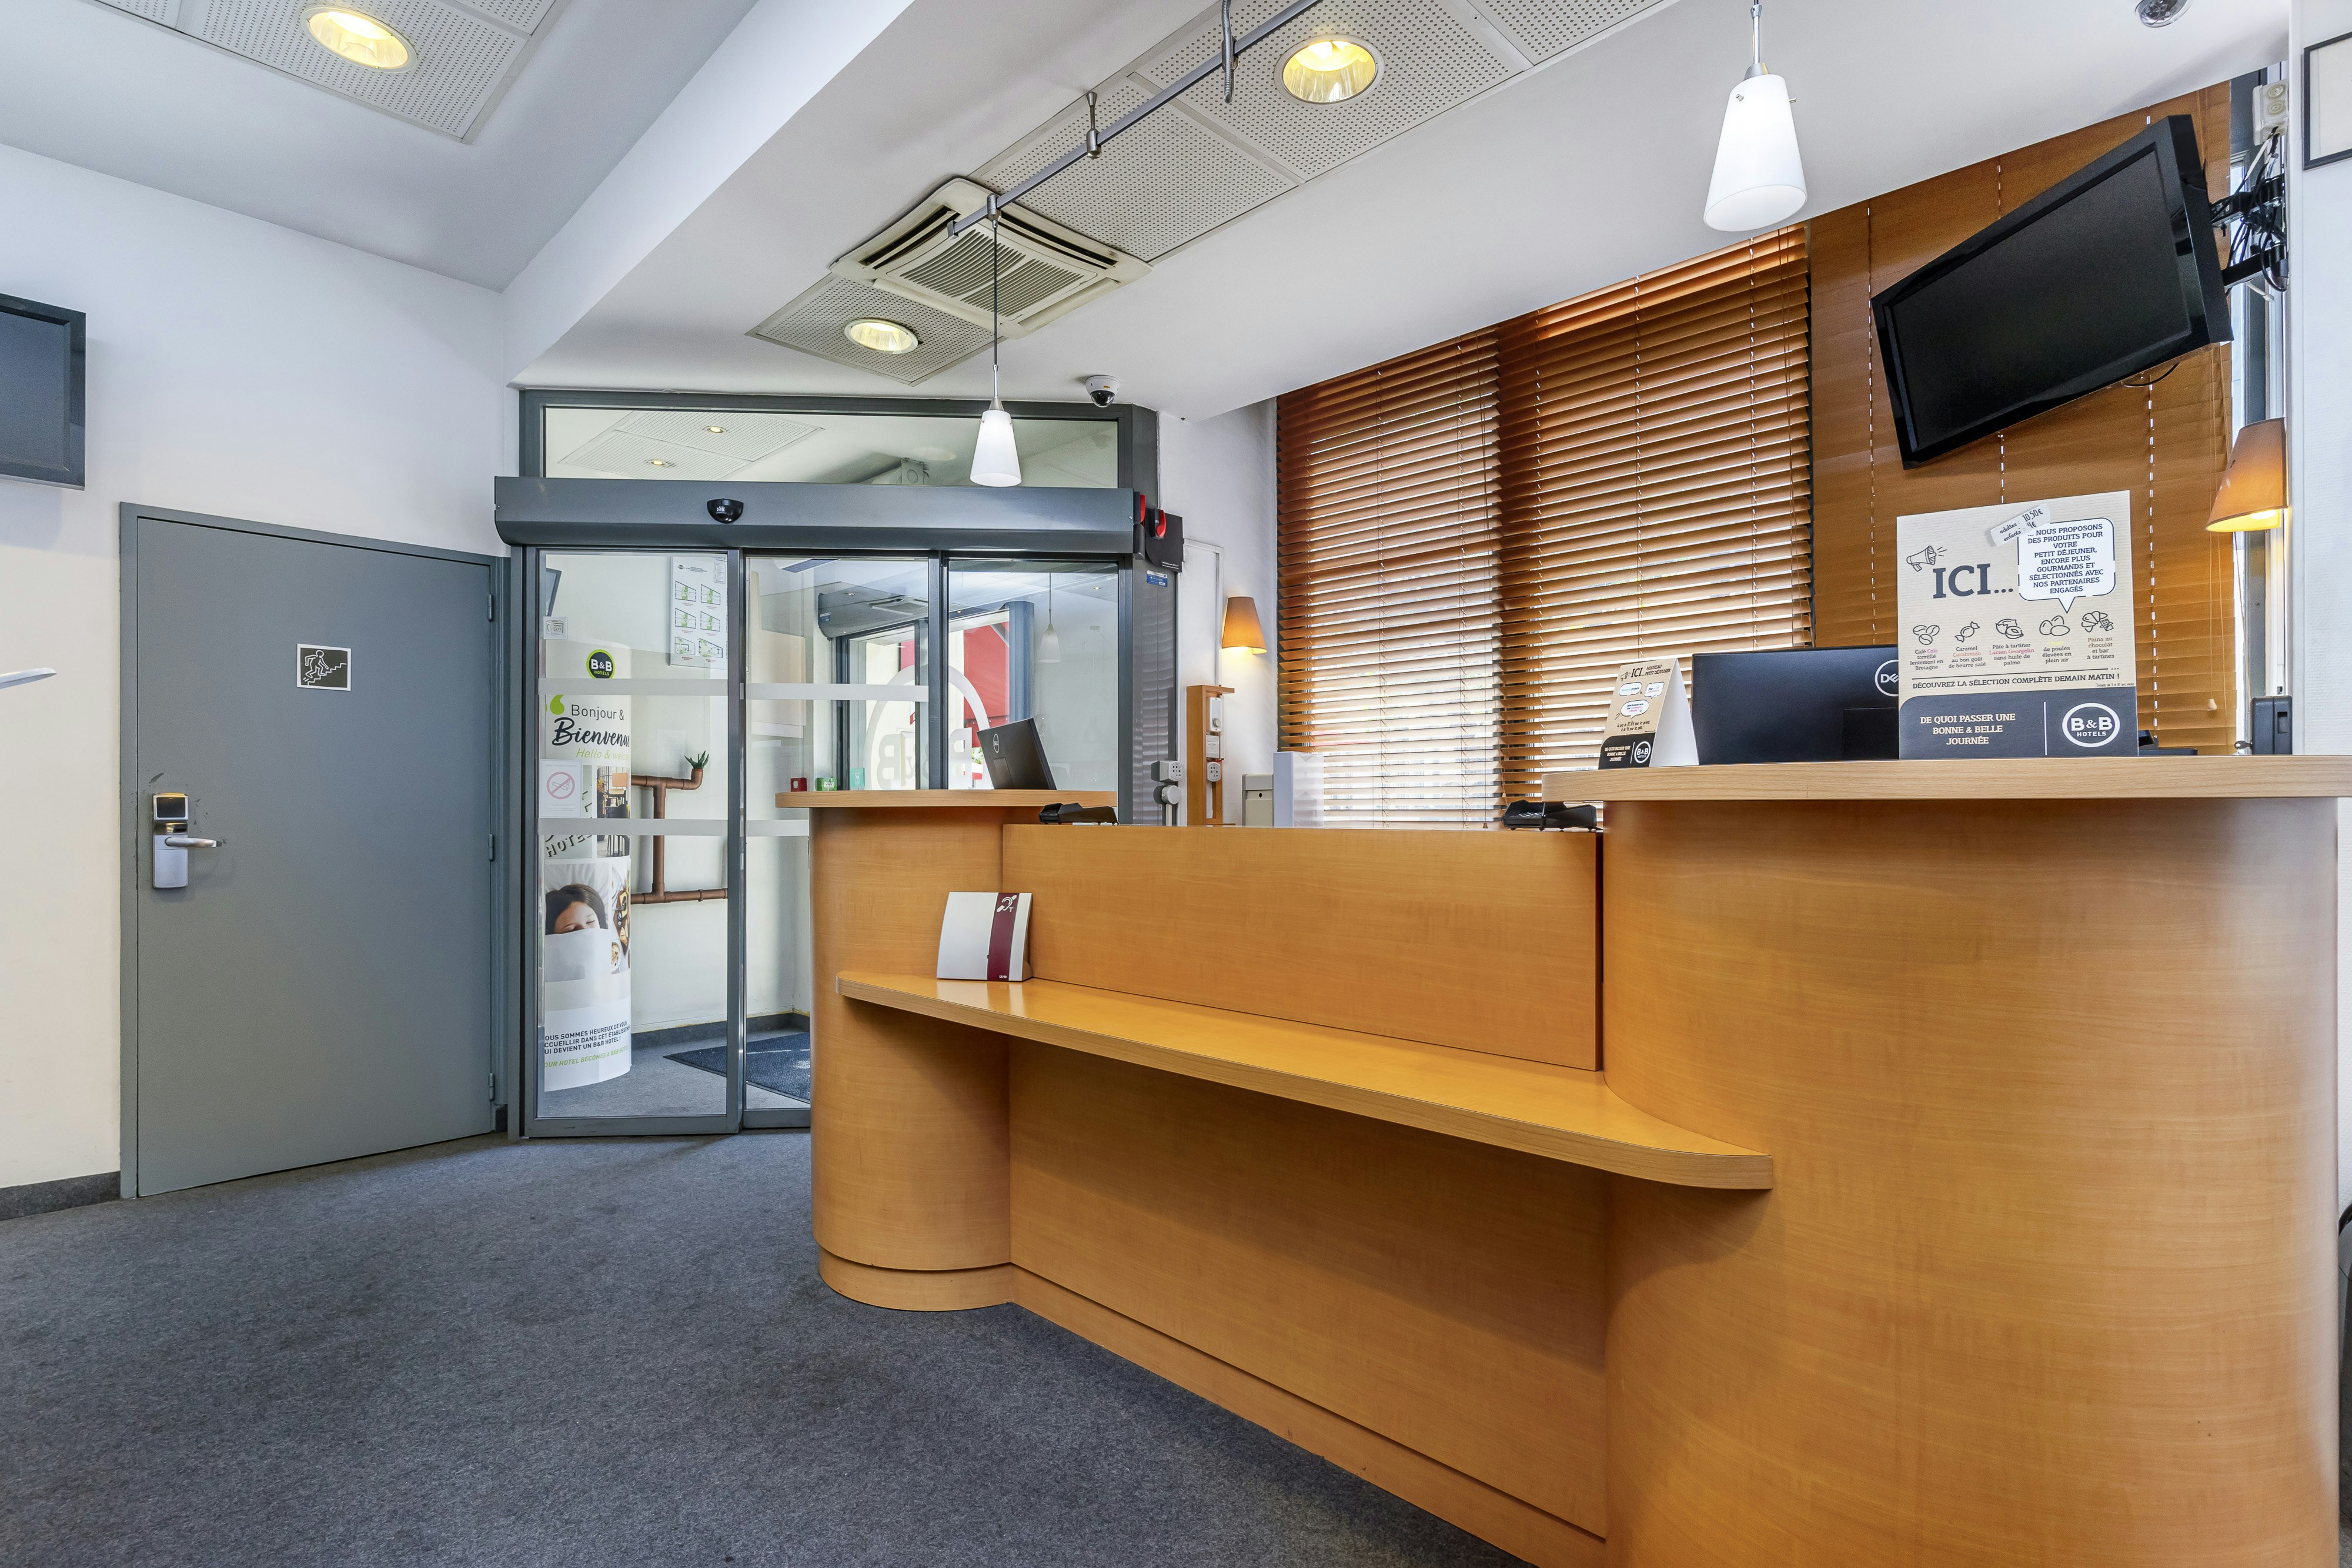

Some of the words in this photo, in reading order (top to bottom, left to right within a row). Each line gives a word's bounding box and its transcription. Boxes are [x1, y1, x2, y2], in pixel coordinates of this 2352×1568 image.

[2000, 522, 2017, 534] adultes
[2022, 509, 2043, 522] 10,50€
[2059, 524, 2103, 533] PROPOSONS
[2043, 534, 2080, 543] PRODUITS
[2057, 547, 2097, 556] DÉJEUNER,
[2037, 563, 2084, 573] GOURMANDS
[2029, 570, 2083, 581] SÉLECTIONNÉS
[1933, 563, 2013, 599] ICI...
[2050, 577, 2100, 587] PARTENAIRES
[591, 658, 612, 672] B&B
[1880, 673, 1899, 683] DE
[2012, 676, 2053, 684] COMPLÈTE
[572, 704, 617, 721] Bonjour
[619, 709, 624, 721] &
[1920, 716, 1932, 724] DE
[1934, 716, 1957, 724] QUOI
[1959, 714, 1993, 723] PASSER
[1996, 713, 2016, 721] UNE
[2071, 717, 2113, 731] B&B
[552, 717, 630, 748] Bienvenu
[1933, 726, 1964, 734] BONNE
[1975, 725, 2003, 733] BELLE
[1946, 735, 1989, 745] JOURNÉE
[576, 748, 602, 758] Hello
[604, 750, 610, 759] &
[560, 1031, 588, 1039] SOMMES
[590, 1026, 613, 1035] HEUREUX
[544, 1039, 579, 1048] CCUEILLIR
[553, 1045, 582, 1054] DEVIENT
[605, 1037, 619, 1045] HOTEL
[581, 1053, 606, 1062] BECOMES
